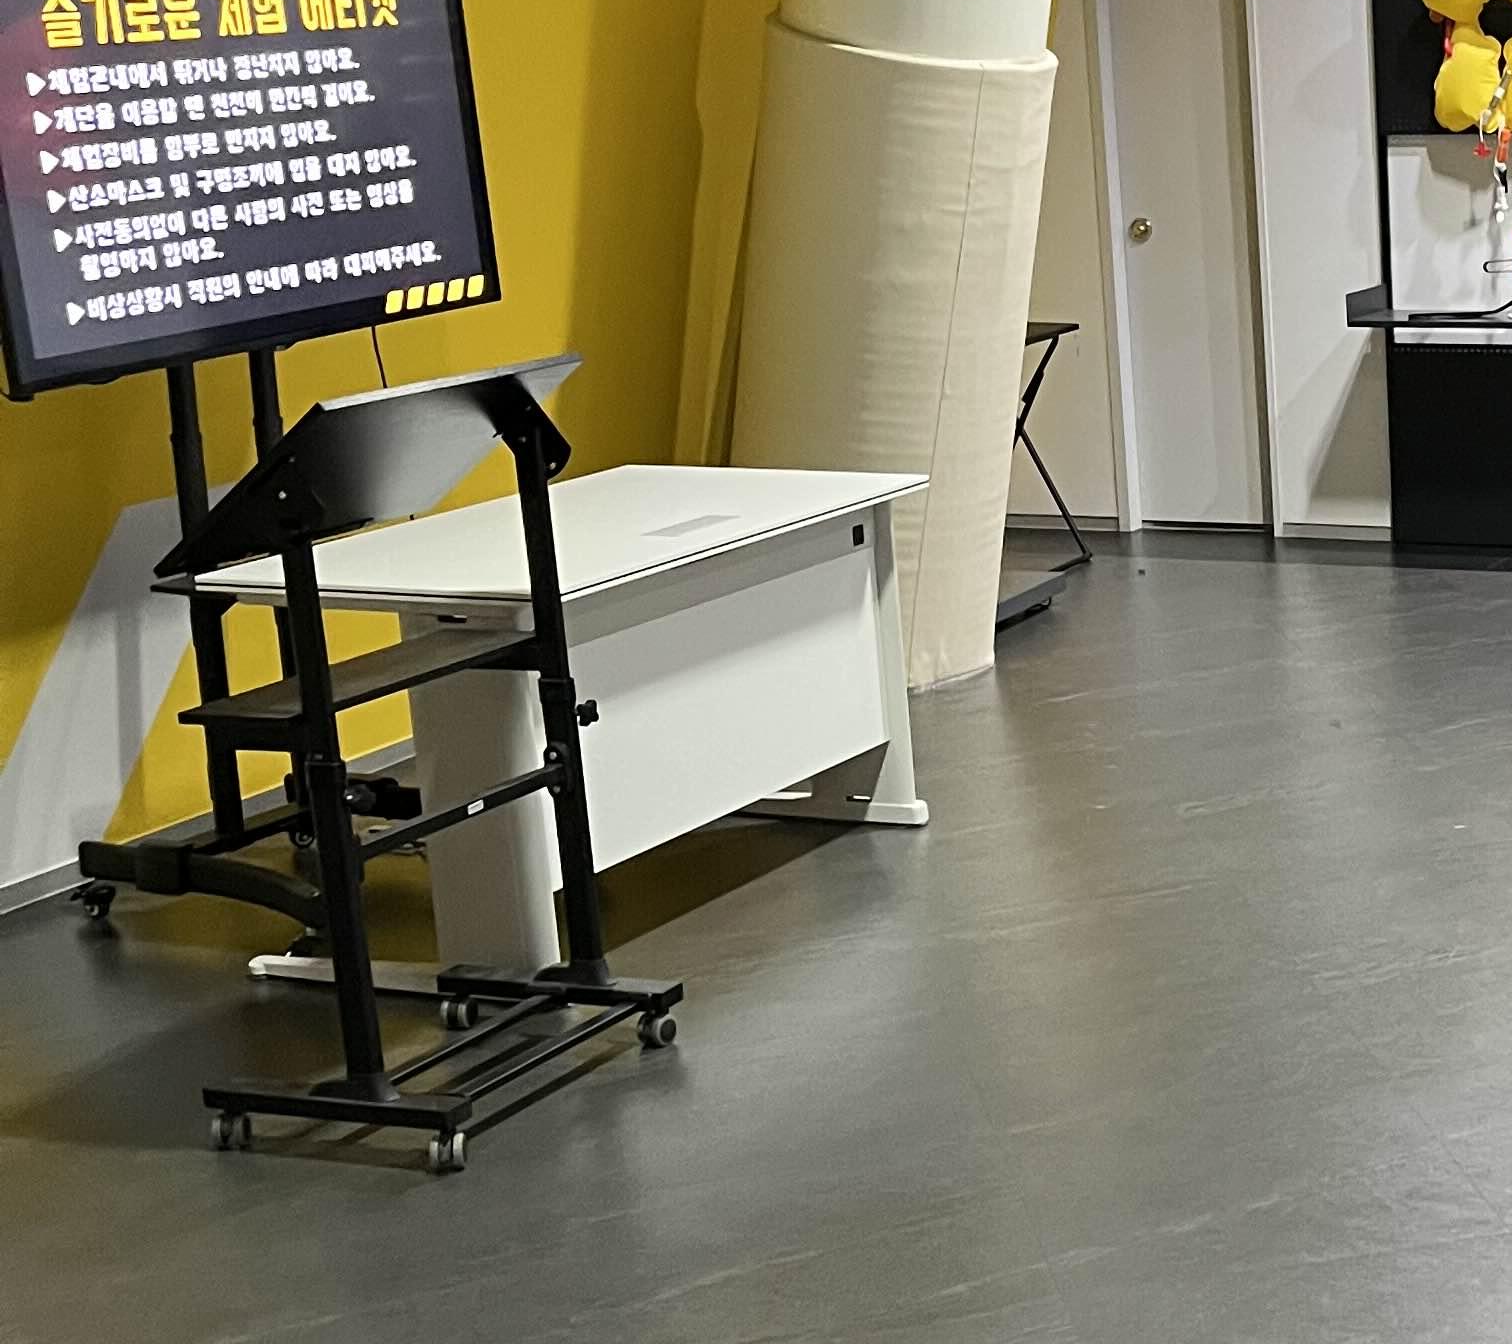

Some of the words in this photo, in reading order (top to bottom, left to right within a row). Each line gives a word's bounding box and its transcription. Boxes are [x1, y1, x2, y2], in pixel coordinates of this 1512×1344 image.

[54, 102, 115, 133] 계단을
[211, 89, 264, 118] 천천히
[224, 125, 276, 154] 만지지
[68, 176, 165, 212] 산소마스크
[169, 172, 190, 198] 및
[191, 204, 229, 232] 다른
[234, 197, 286, 226] 사람의
[291, 191, 325, 218] 사진
[329, 187, 363, 212] 또는
[86, 283, 183, 321] 비상상황시
[187, 272, 241, 304] 직원의
[245, 263, 300, 294] 안내에
[304, 256, 339, 284] 따라
